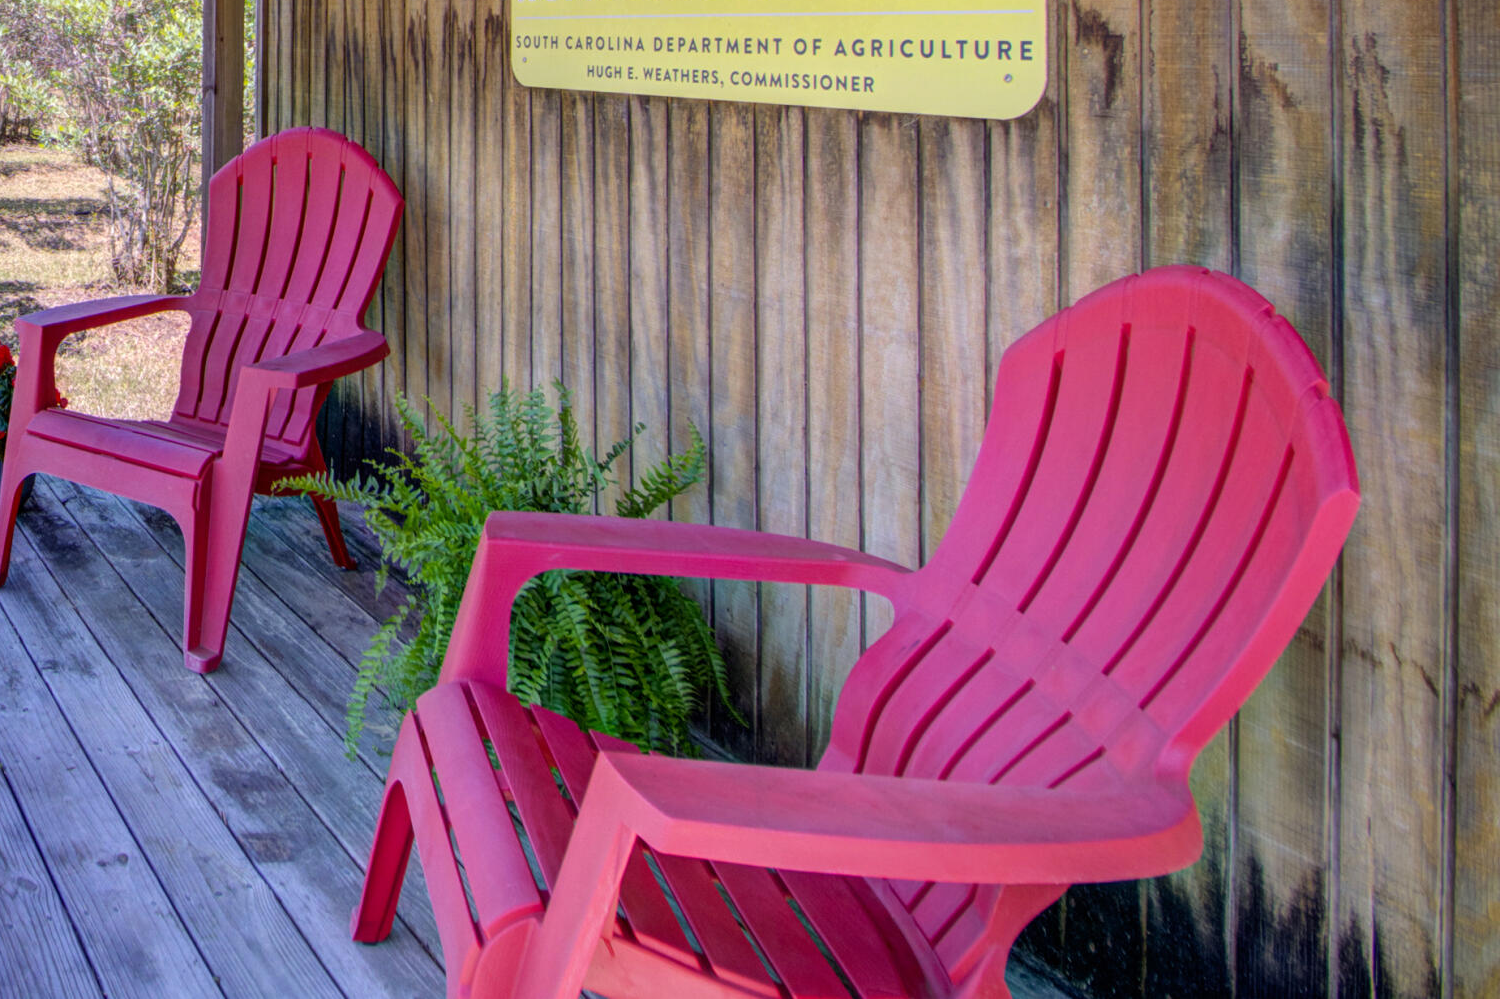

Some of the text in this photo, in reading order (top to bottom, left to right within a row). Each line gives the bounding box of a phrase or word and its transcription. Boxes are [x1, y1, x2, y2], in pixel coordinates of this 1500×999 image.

[516, 35, 1034, 61] SOUTH CAROLINA DEPARTMENT OF AGRICULTURE
[587, 65, 875, 93] HUGH E. WEATHERS, COMMISSIONER
